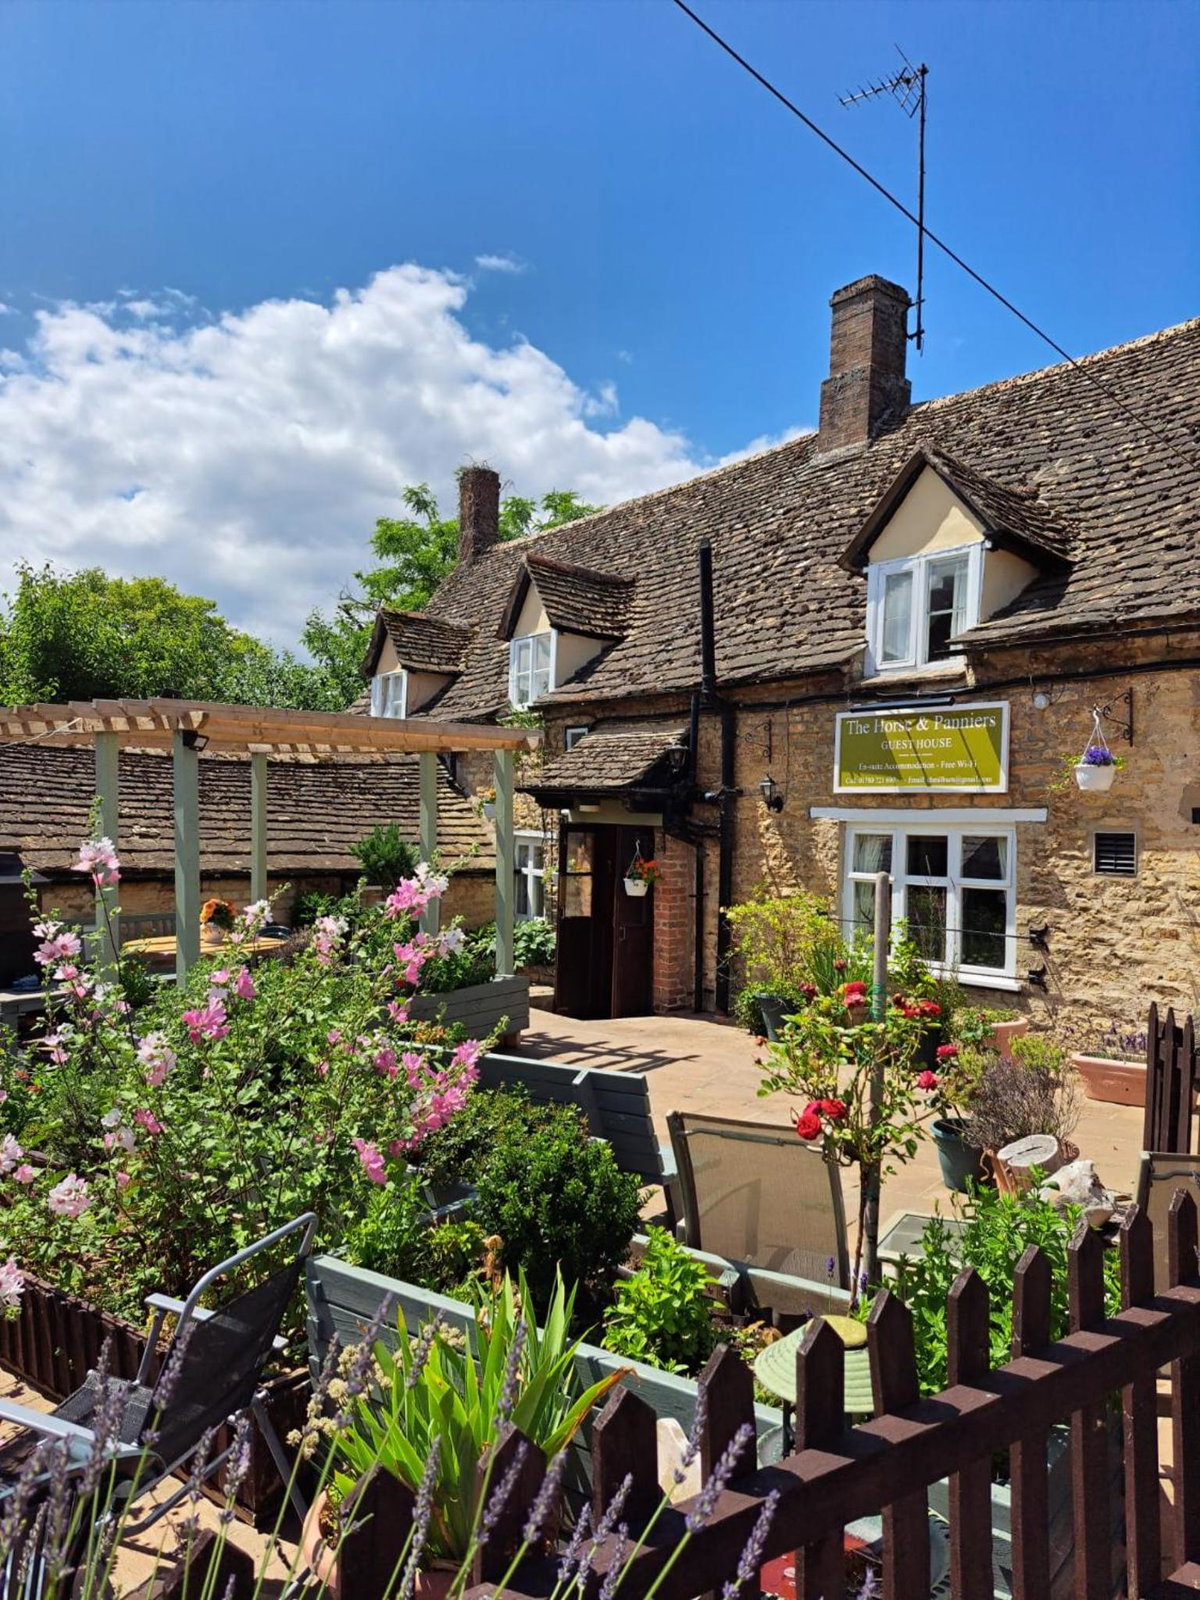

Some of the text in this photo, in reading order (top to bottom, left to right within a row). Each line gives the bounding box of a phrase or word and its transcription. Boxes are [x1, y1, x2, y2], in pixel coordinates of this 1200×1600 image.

[846, 712, 996, 735] The Horse & Panniers
[880, 738, 953, 750] GUEST HOUSE
[940, 760, 956, 769] Free
